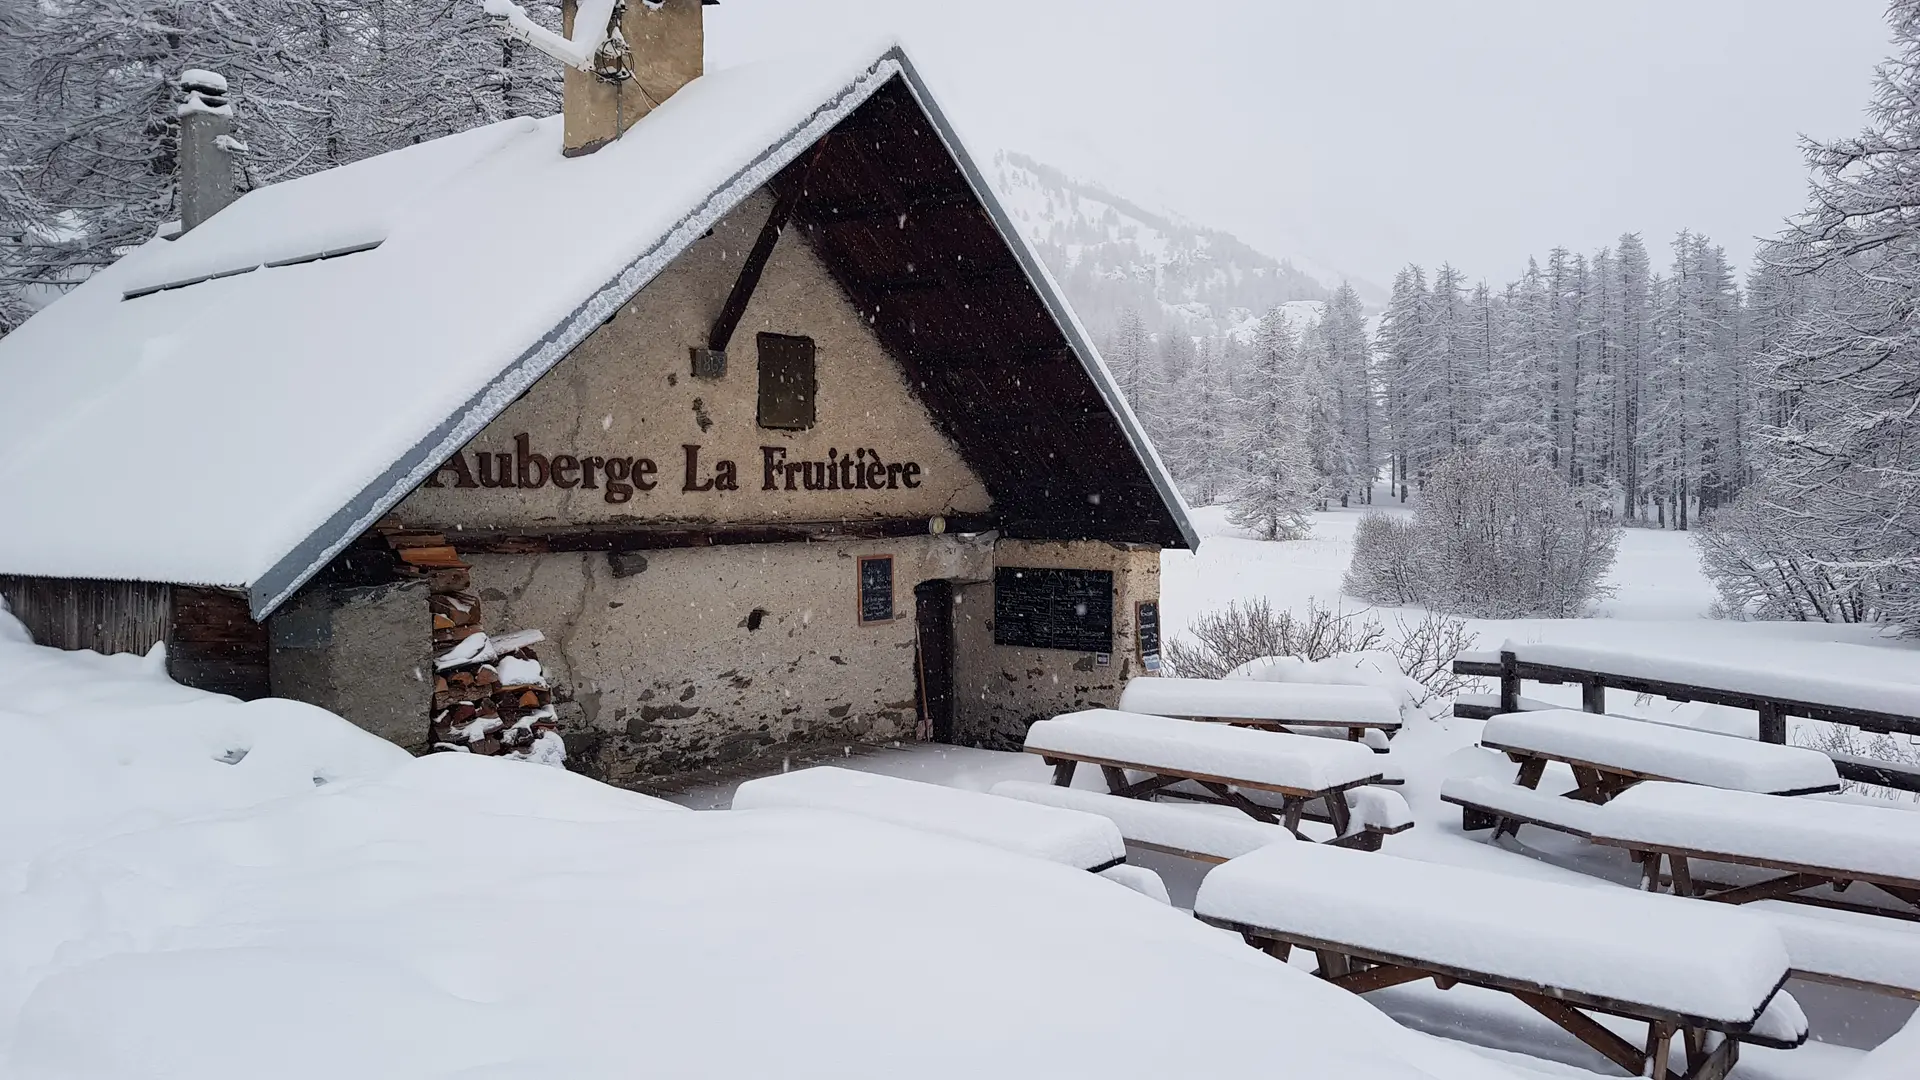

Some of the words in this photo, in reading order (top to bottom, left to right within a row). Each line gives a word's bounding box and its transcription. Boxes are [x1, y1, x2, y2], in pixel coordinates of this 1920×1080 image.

[424, 432, 658, 504] Auberge
[682, 444, 739, 491] La
[759, 446, 921, 491] Fruitière
